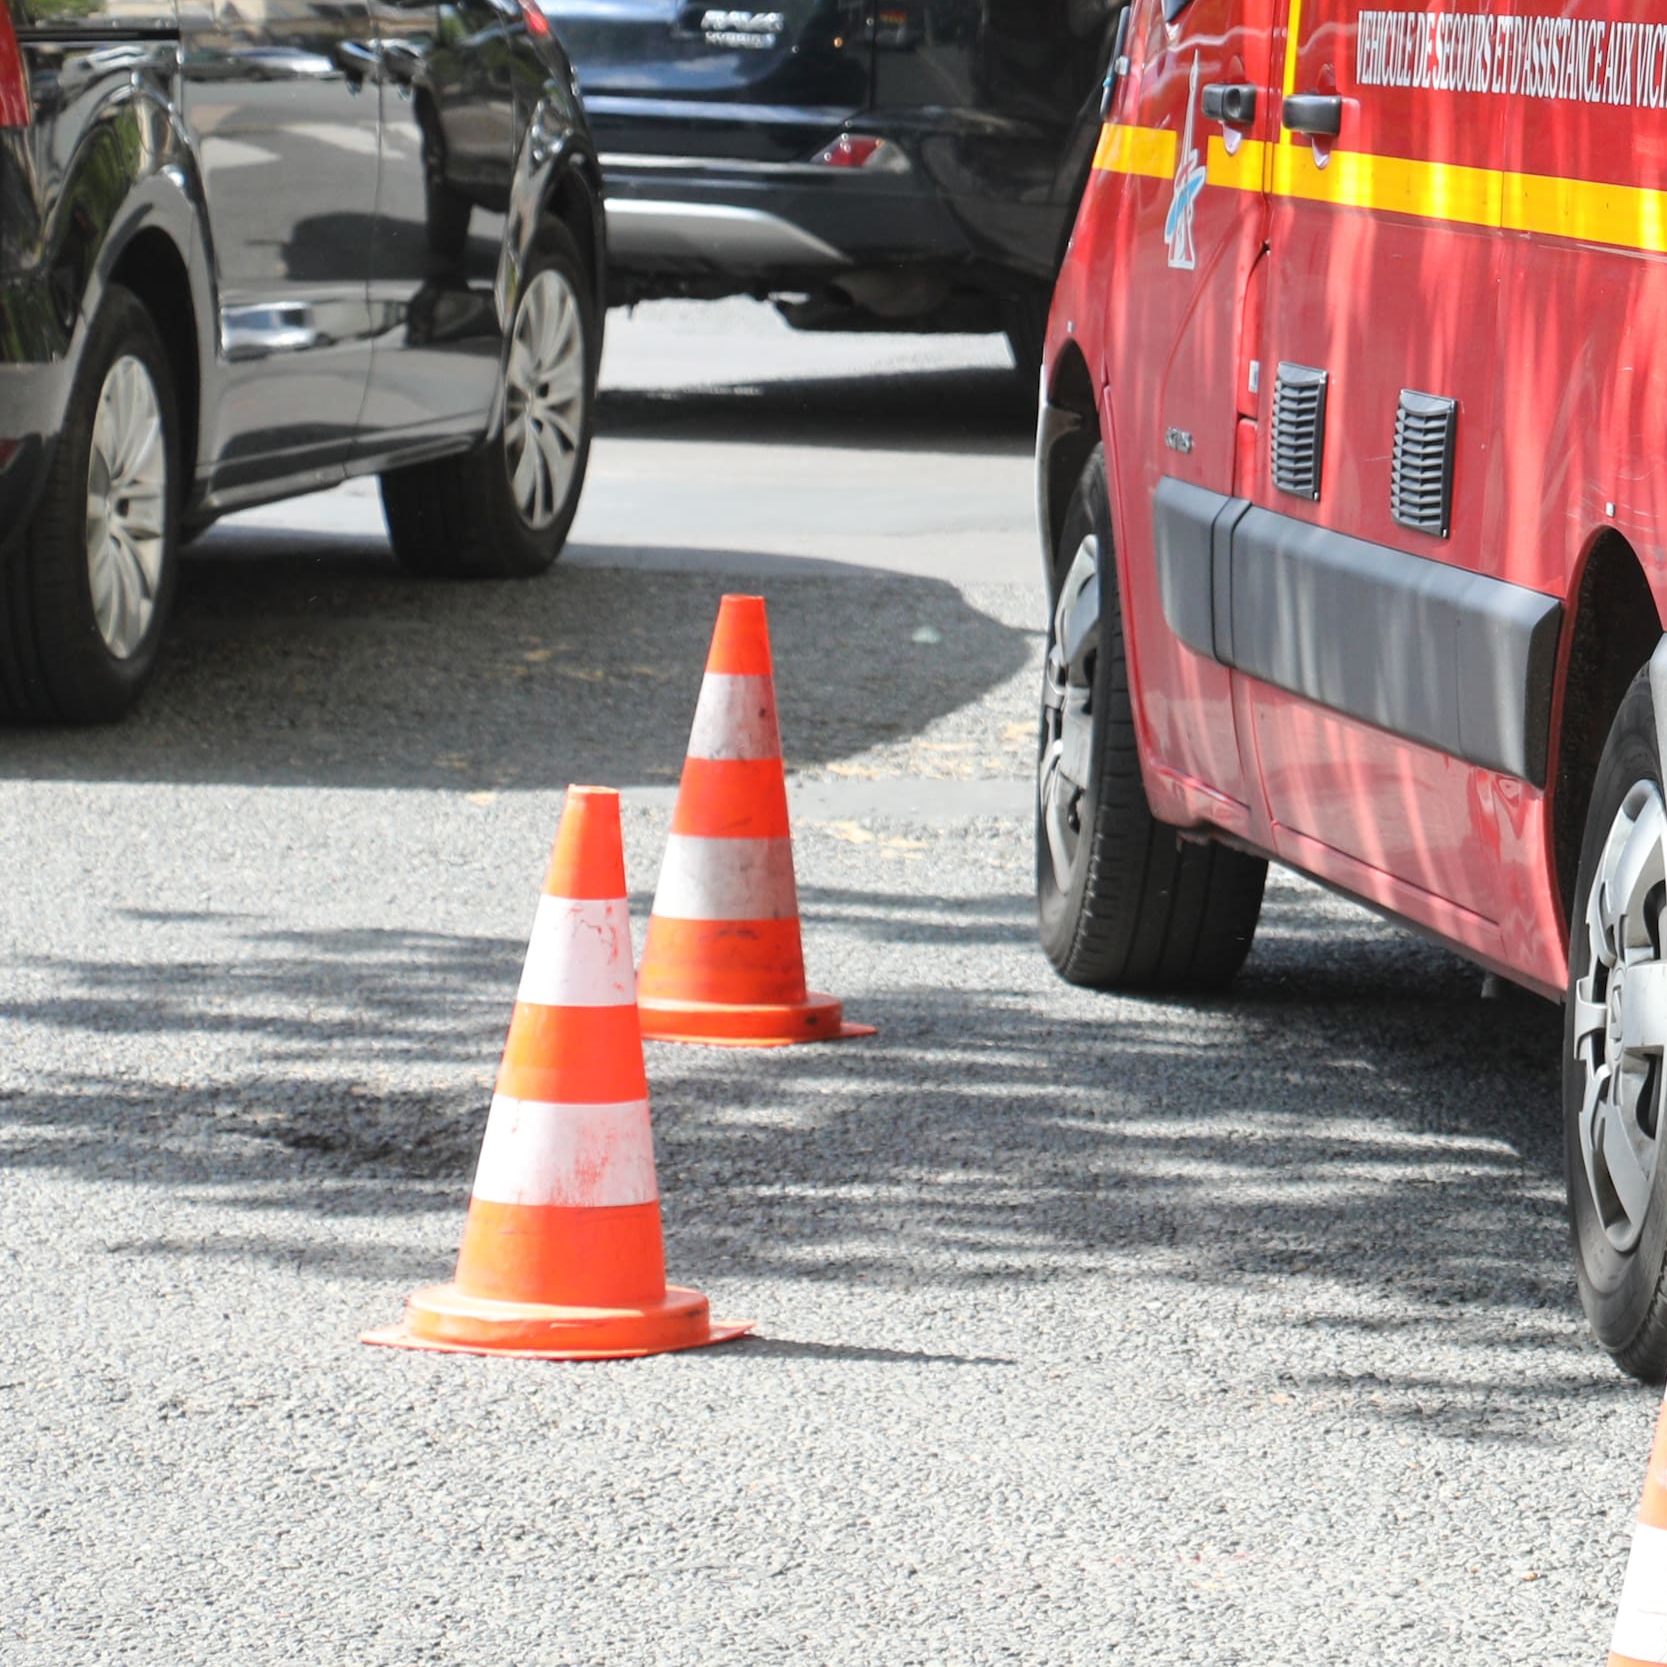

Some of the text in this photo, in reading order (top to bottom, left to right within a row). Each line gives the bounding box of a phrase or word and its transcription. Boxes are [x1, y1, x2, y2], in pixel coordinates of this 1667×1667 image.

[1356, 10, 1415, 88] VEHICULE
[1412, 11, 1436, 89] DE
[1432, 12, 1494, 94] SECOURS
[1491, 15, 1514, 94] ET
[1510, 16, 1606, 103] D'ASSISTANCE
[1602, 21, 1637, 107] AUX
